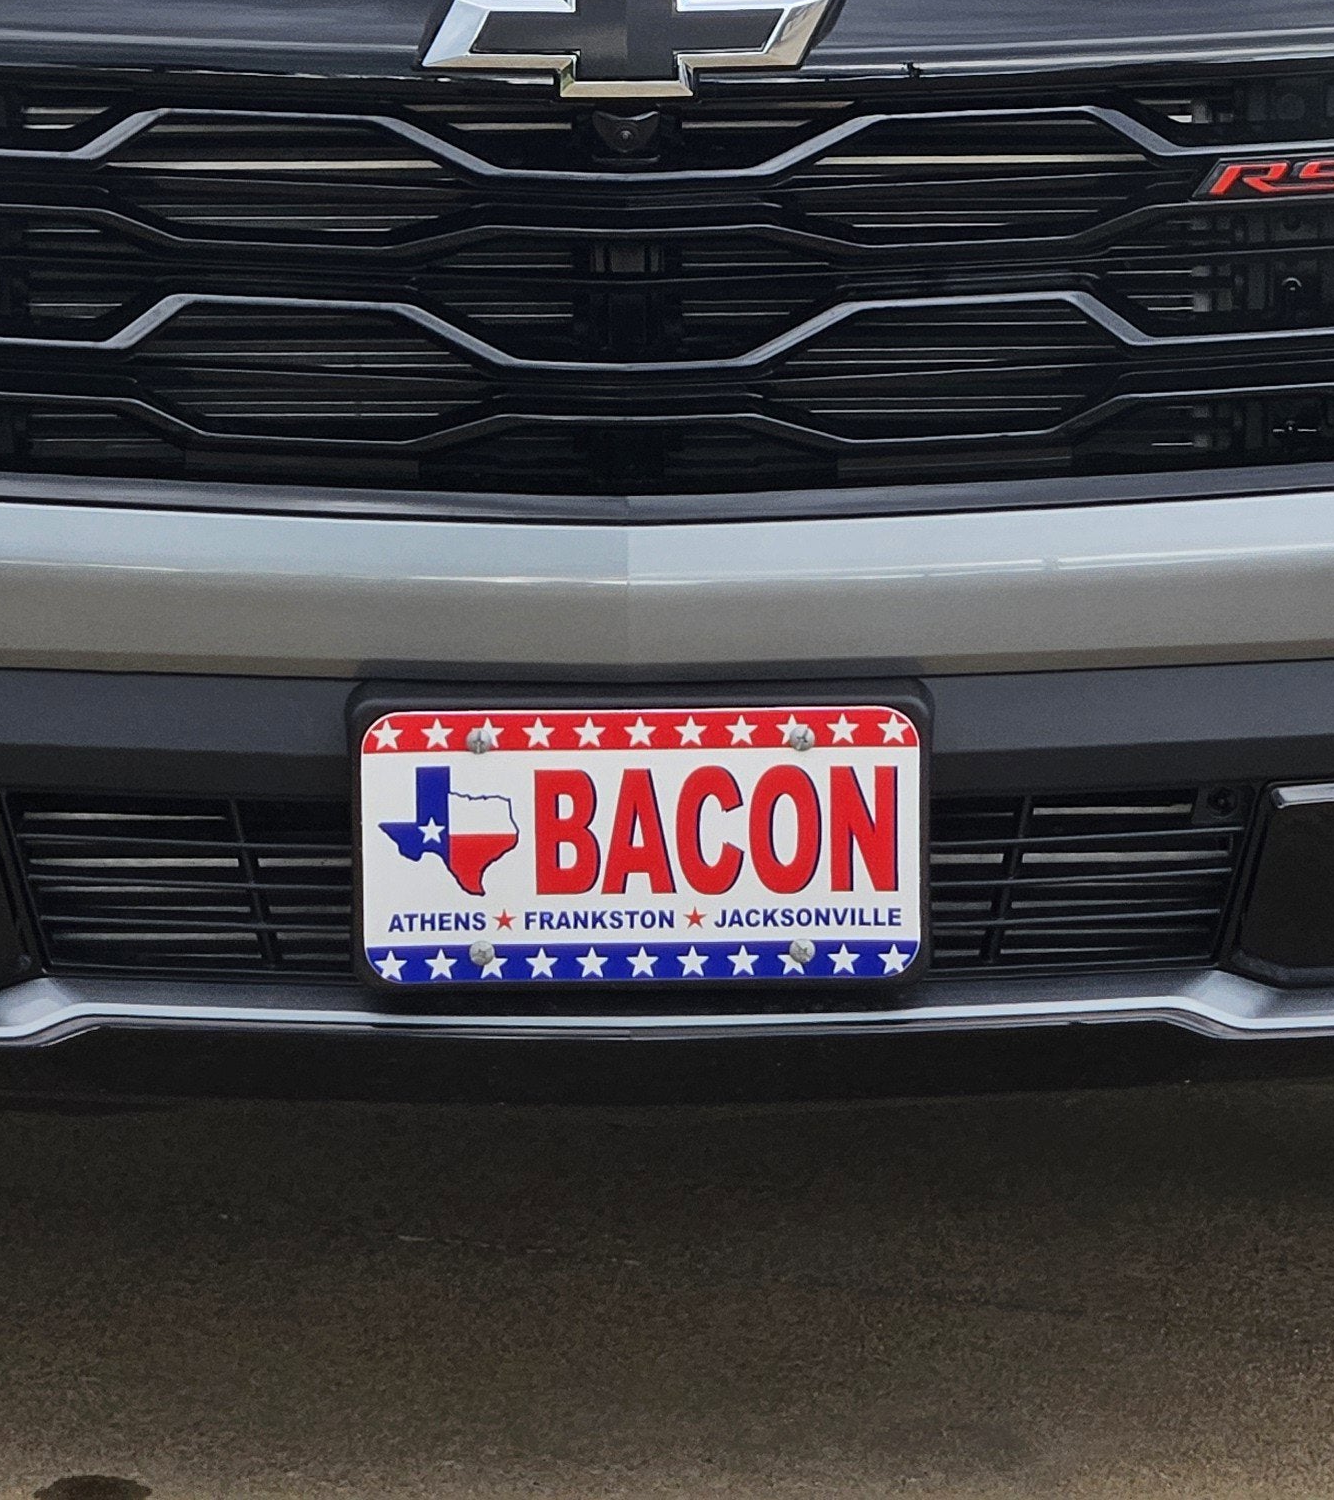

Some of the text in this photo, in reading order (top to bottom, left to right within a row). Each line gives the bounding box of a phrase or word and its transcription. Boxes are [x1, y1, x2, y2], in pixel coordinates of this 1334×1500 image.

[534, 764, 899, 896] BACON
[388, 907, 902, 933] ATHENS FRANKSTON JACKSONVILLE
